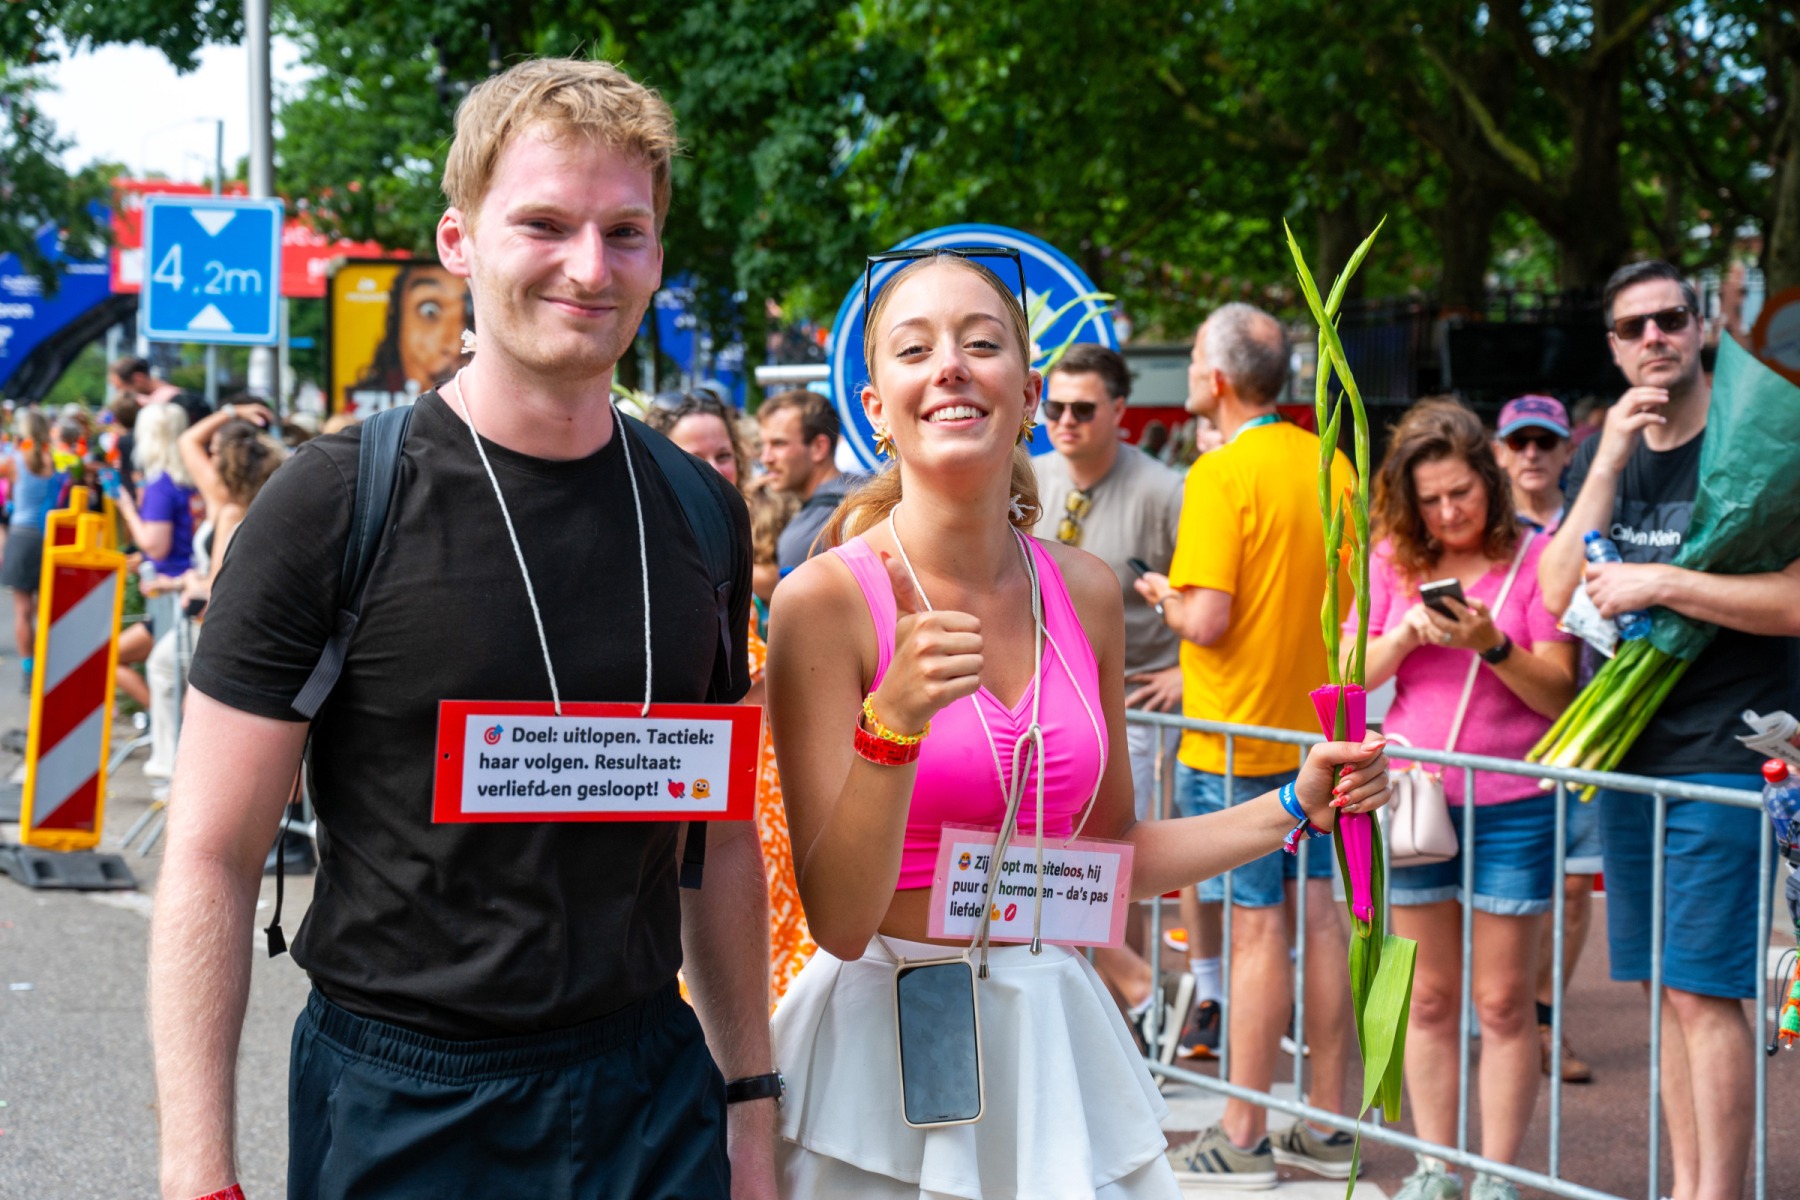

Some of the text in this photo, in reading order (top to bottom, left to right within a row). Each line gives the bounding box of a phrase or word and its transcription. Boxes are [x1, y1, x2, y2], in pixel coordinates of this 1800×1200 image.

[1649, 529, 1681, 547] Klein
[512, 727, 714, 747] Doel: uitlopen. Tactiek:
[479, 753, 681, 774] haar volgen. Resultaat:
[577, 781, 658, 801] gesloopt!
[974, 855, 990, 874] Zij
[996, 859, 1021, 876] opt
[1087, 864, 1102, 882] hij
[952, 879, 979, 895] puur
[1090, 890, 1108, 905] pas
